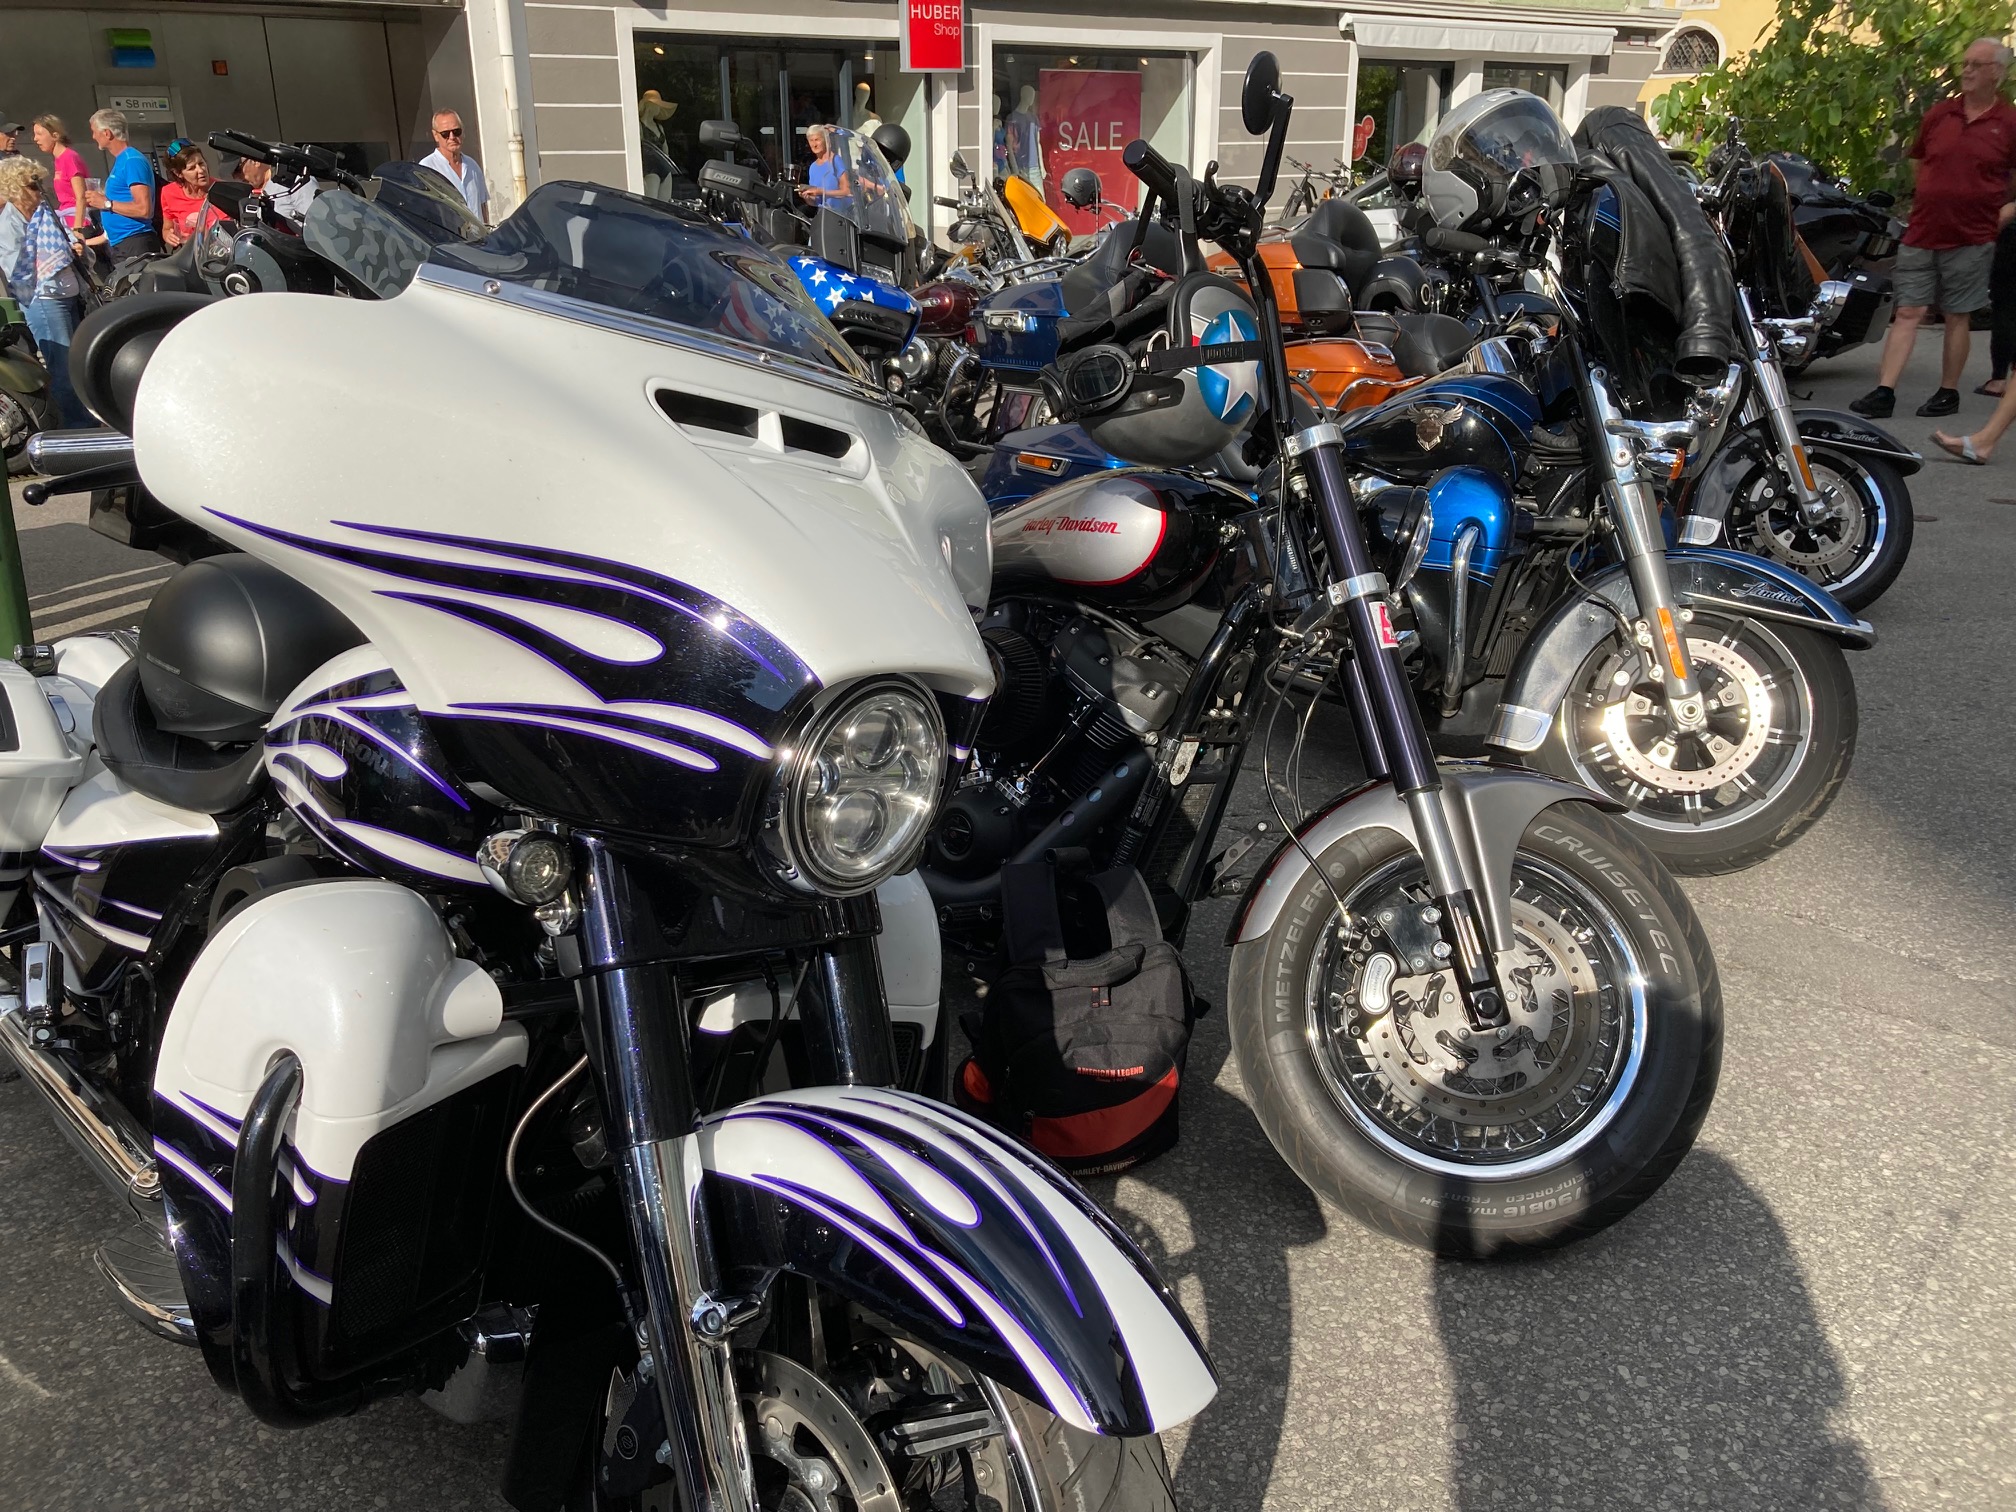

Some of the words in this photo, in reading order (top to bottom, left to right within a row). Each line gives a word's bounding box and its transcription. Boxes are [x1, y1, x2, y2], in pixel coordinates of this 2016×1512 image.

[911, 4, 960, 20] HUBER
[934, 22, 960, 39] Shop
[125, 98, 140, 109] SB
[142, 99, 159, 109] mit
[1058, 121, 1124, 151] SALE
[1022, 516, 1121, 535] Harley-Davidson
[1730, 582, 1804, 607] Limited
[1533, 825, 1682, 976] CRUISETEC
[1275, 878, 1330, 1023] METZELER
[1076, 1066, 1116, 1077] AMERICAN
[1117, 1065, 1144, 1077] LEGEND
[1505, 1167, 1594, 1204] REINFORCED
[1439, 1192, 1491, 1204] FRONT
